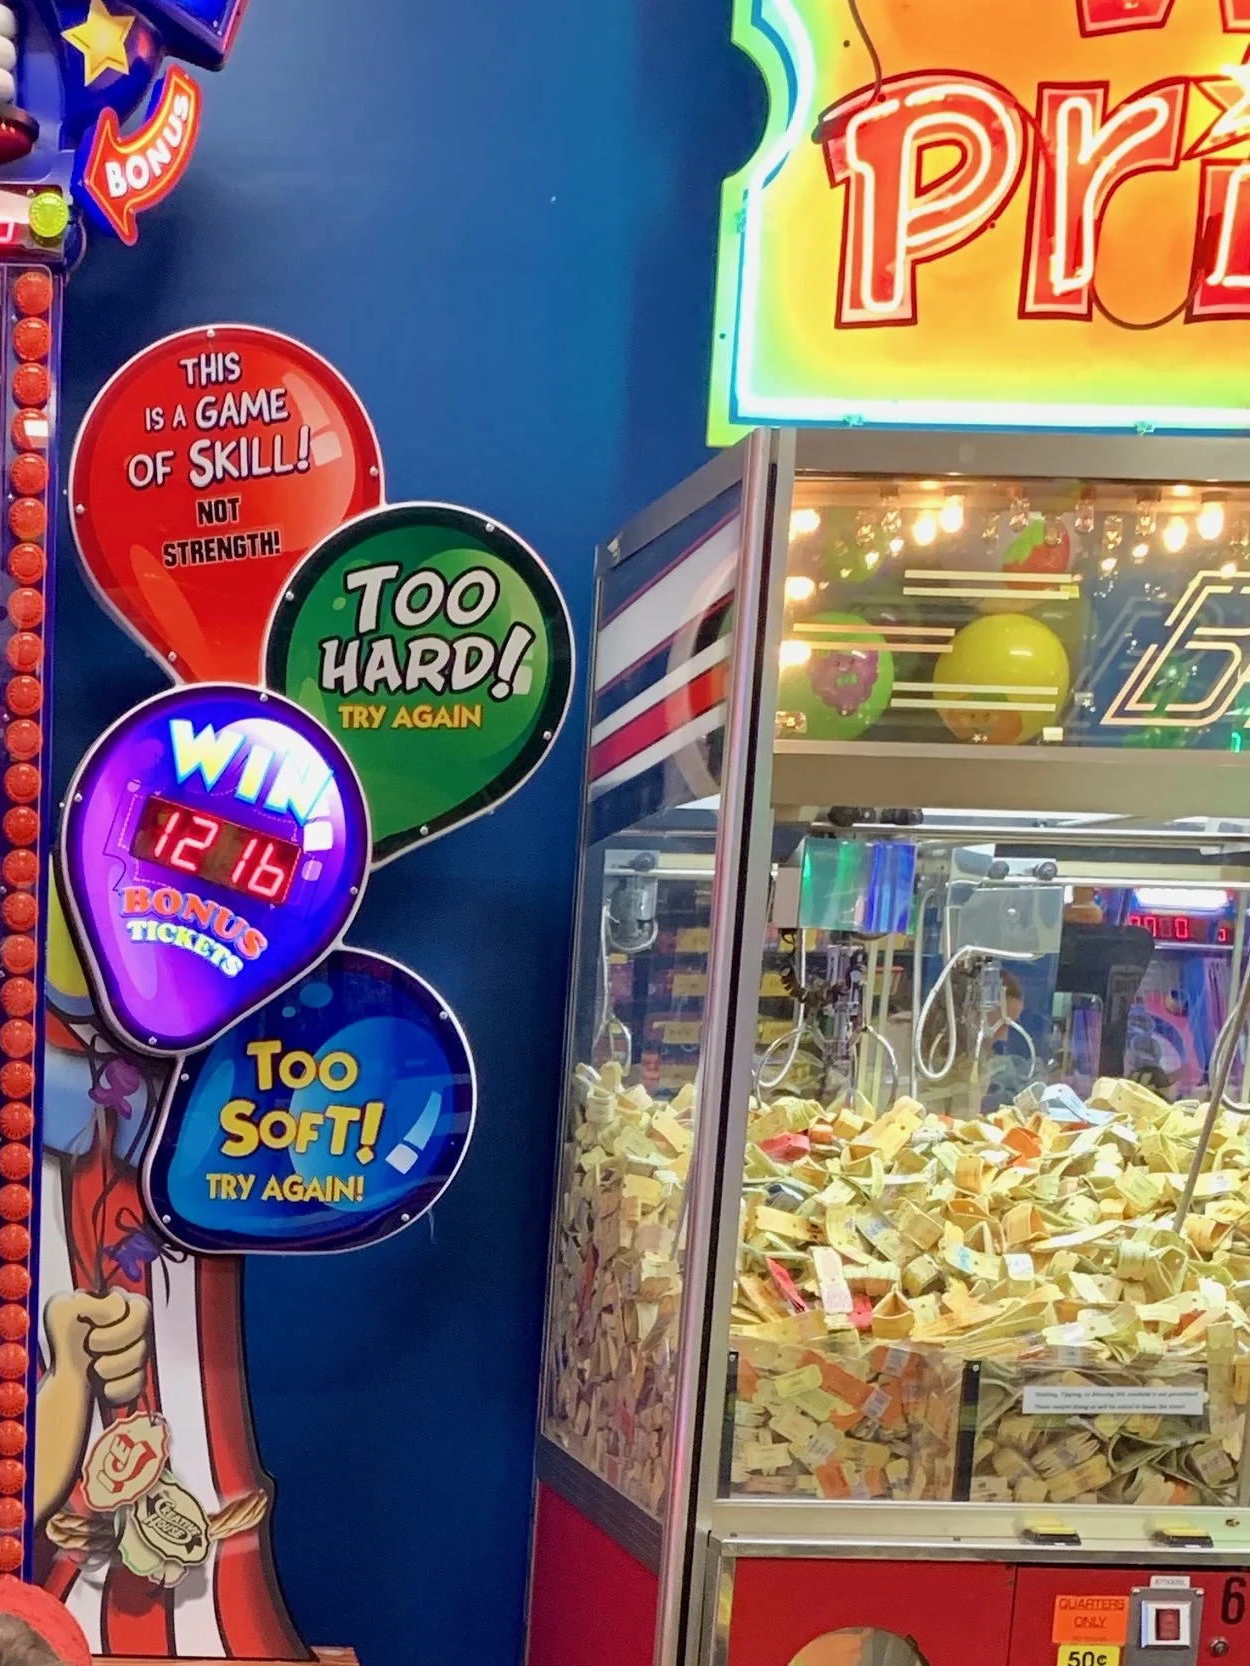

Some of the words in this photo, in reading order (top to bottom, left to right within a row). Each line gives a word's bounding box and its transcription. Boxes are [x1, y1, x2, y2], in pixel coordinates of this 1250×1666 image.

[104, 94, 189, 198] BONUS
[179, 350, 243, 388] THIS
[144, 405, 166, 432] IS
[171, 407, 188, 429] A
[195, 387, 290, 430] GAME
[127, 449, 175, 489] OF
[188, 424, 312, 491] SKILL!
[196, 497, 242, 525] NOT
[162, 529, 282, 569] STRENGTH!
[343, 560, 501, 636] TOO
[317, 620, 537, 702] HARD!
[337, 704, 384, 731] TRY
[390, 704, 484, 731] AGAIN
[168, 717, 335, 828] WIN
[121, 885, 269, 961] BONUS
[126, 919, 245, 979] TICKETS
[245, 1038, 361, 1094] TOO
[218, 1099, 386, 1167] SOFT!
[206, 1173, 257, 1203] TRY
[262, 1173, 366, 1204] AGAIN!
[141, 1513, 188, 1541] HOUSE
[1058, 1598, 1125, 1611] QUARTERS
[1073, 1615, 1108, 1629] ONLY
[1221, 1576, 1247, 1625] 6
